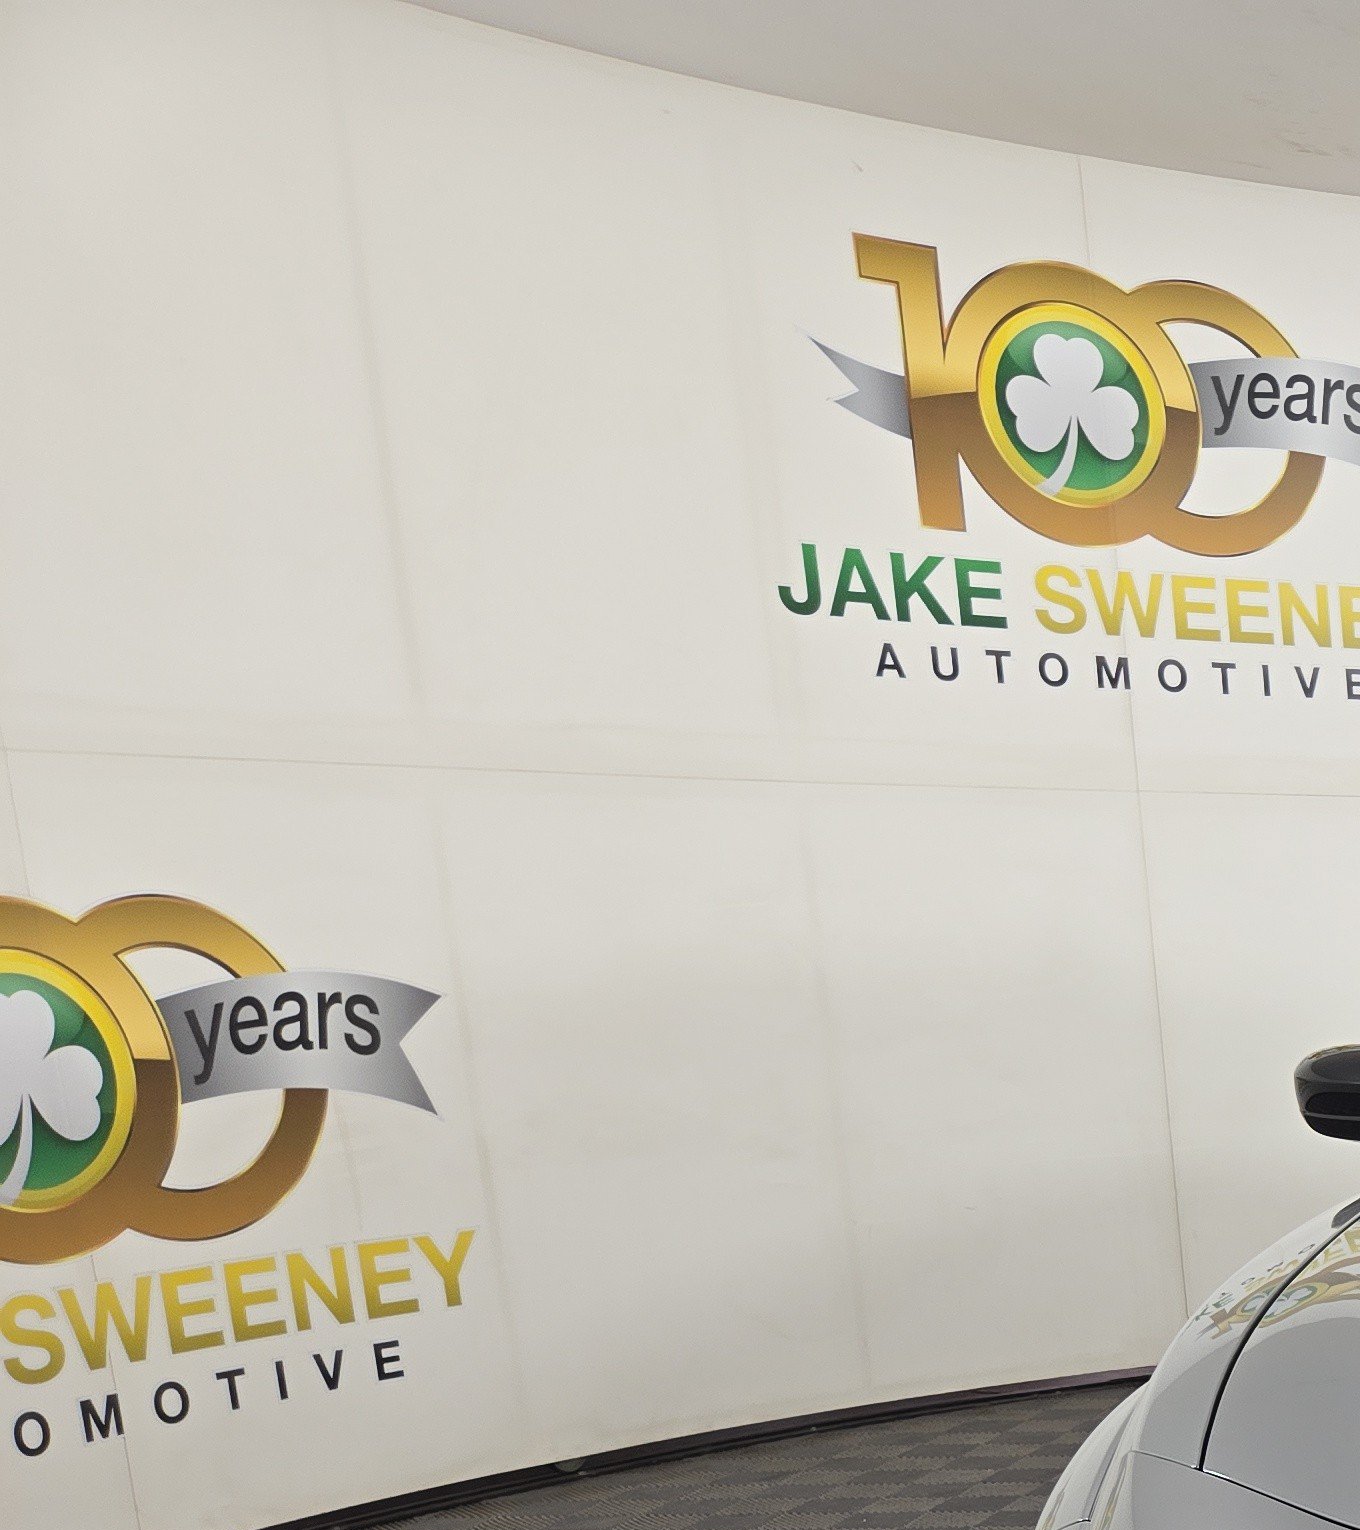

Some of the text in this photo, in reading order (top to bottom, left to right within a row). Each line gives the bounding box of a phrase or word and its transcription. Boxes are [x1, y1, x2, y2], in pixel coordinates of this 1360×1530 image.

[851, 231, 1327, 558] 100
[777, 541, 1009, 630] JAKE
[183, 990, 382, 1085] years
[0, 1230, 477, 1386] SWEENEY
